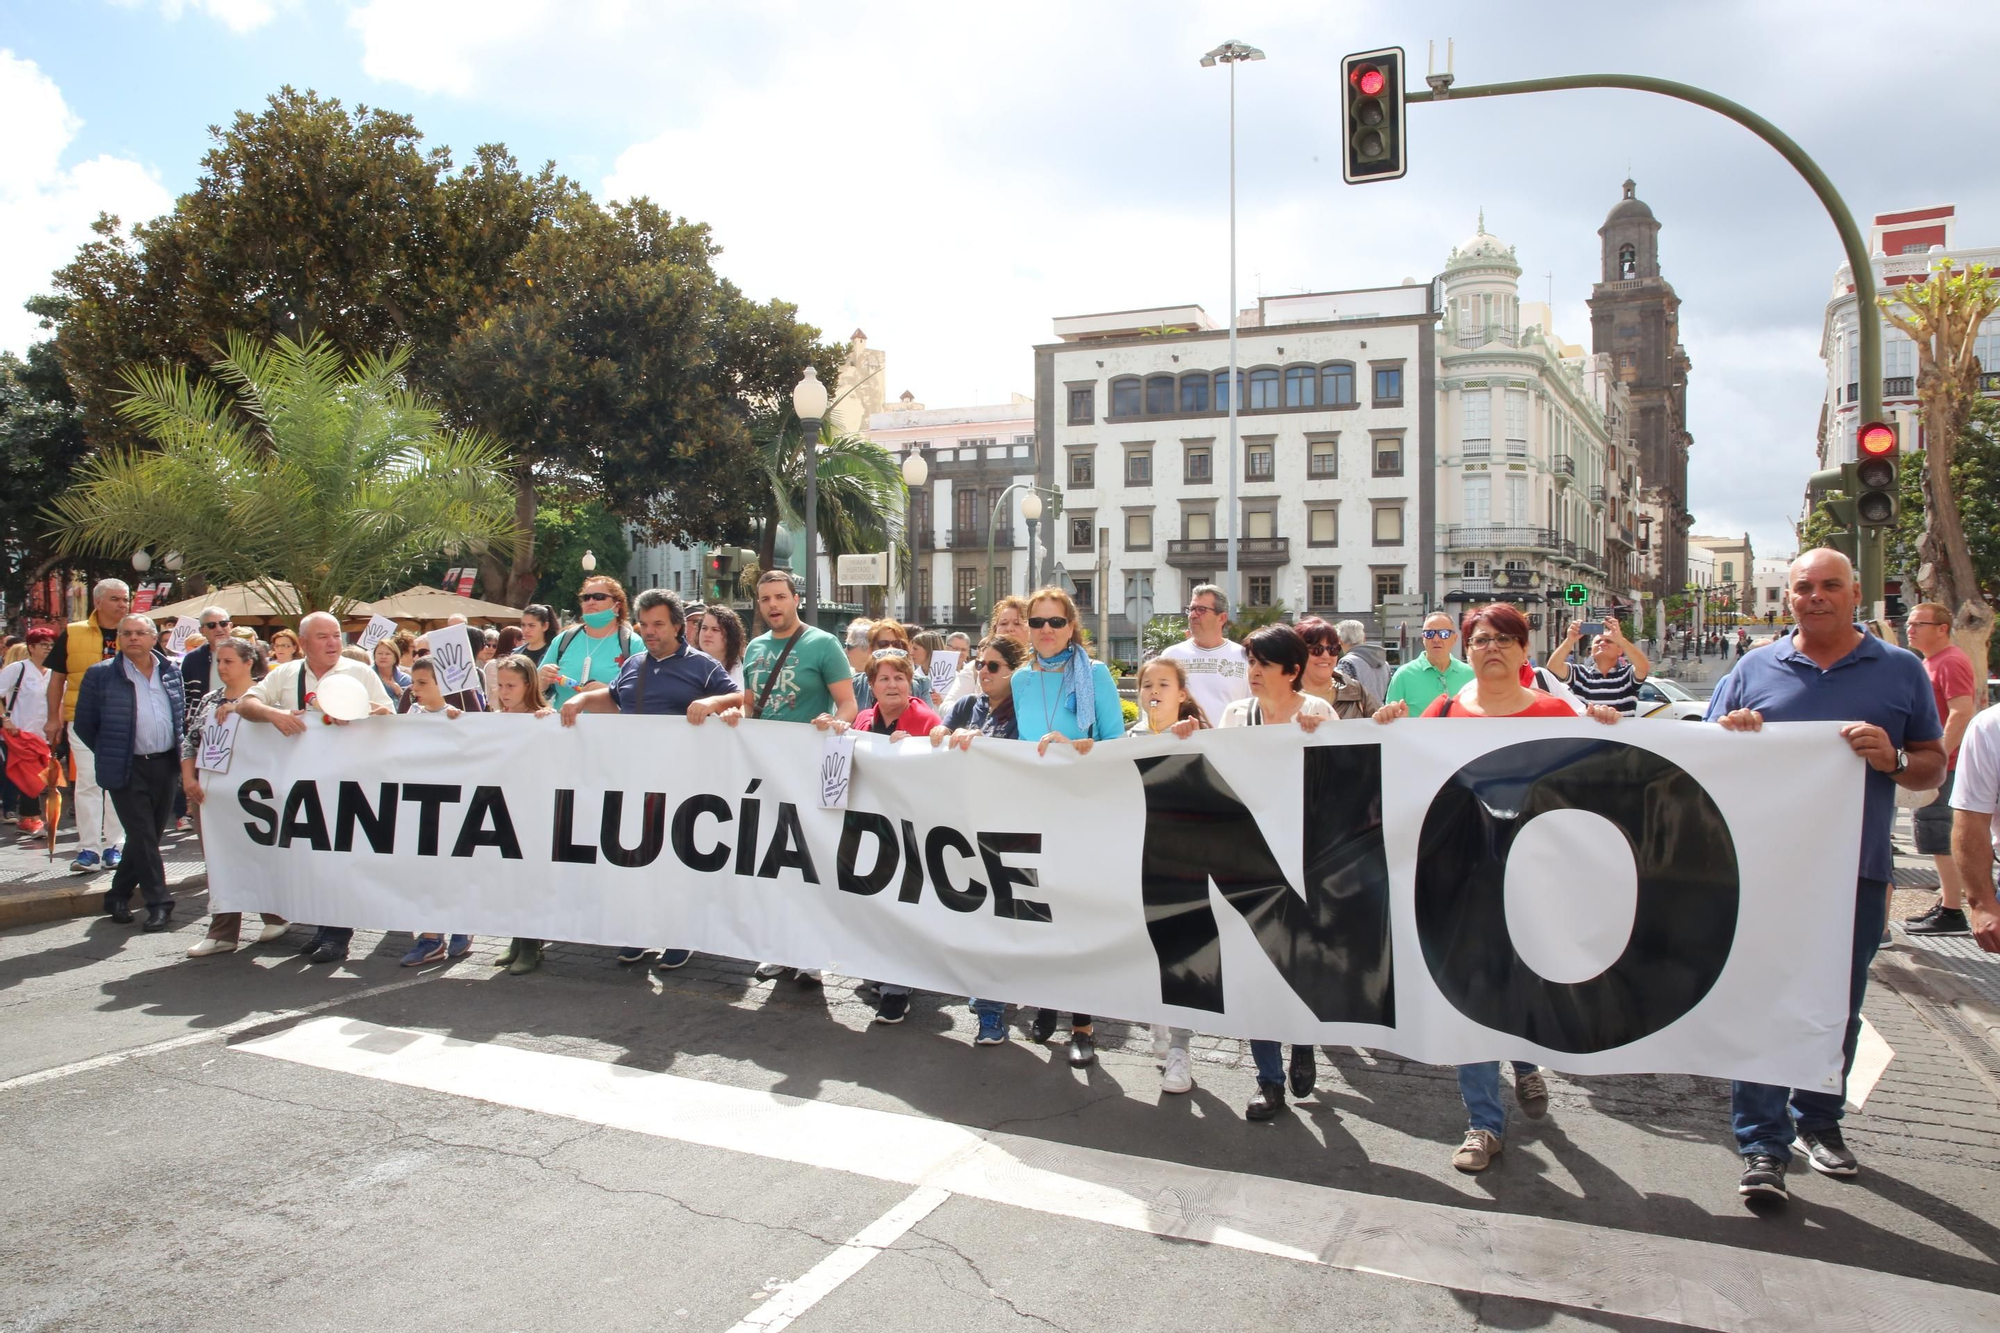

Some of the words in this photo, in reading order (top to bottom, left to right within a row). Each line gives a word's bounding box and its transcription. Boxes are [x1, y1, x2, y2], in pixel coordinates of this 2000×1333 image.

[237, 778, 523, 860] SANTA
[551, 778, 820, 885] LUCÍA
[836, 809, 1053, 923] DICE
[1140, 738, 1740, 1055] NO
